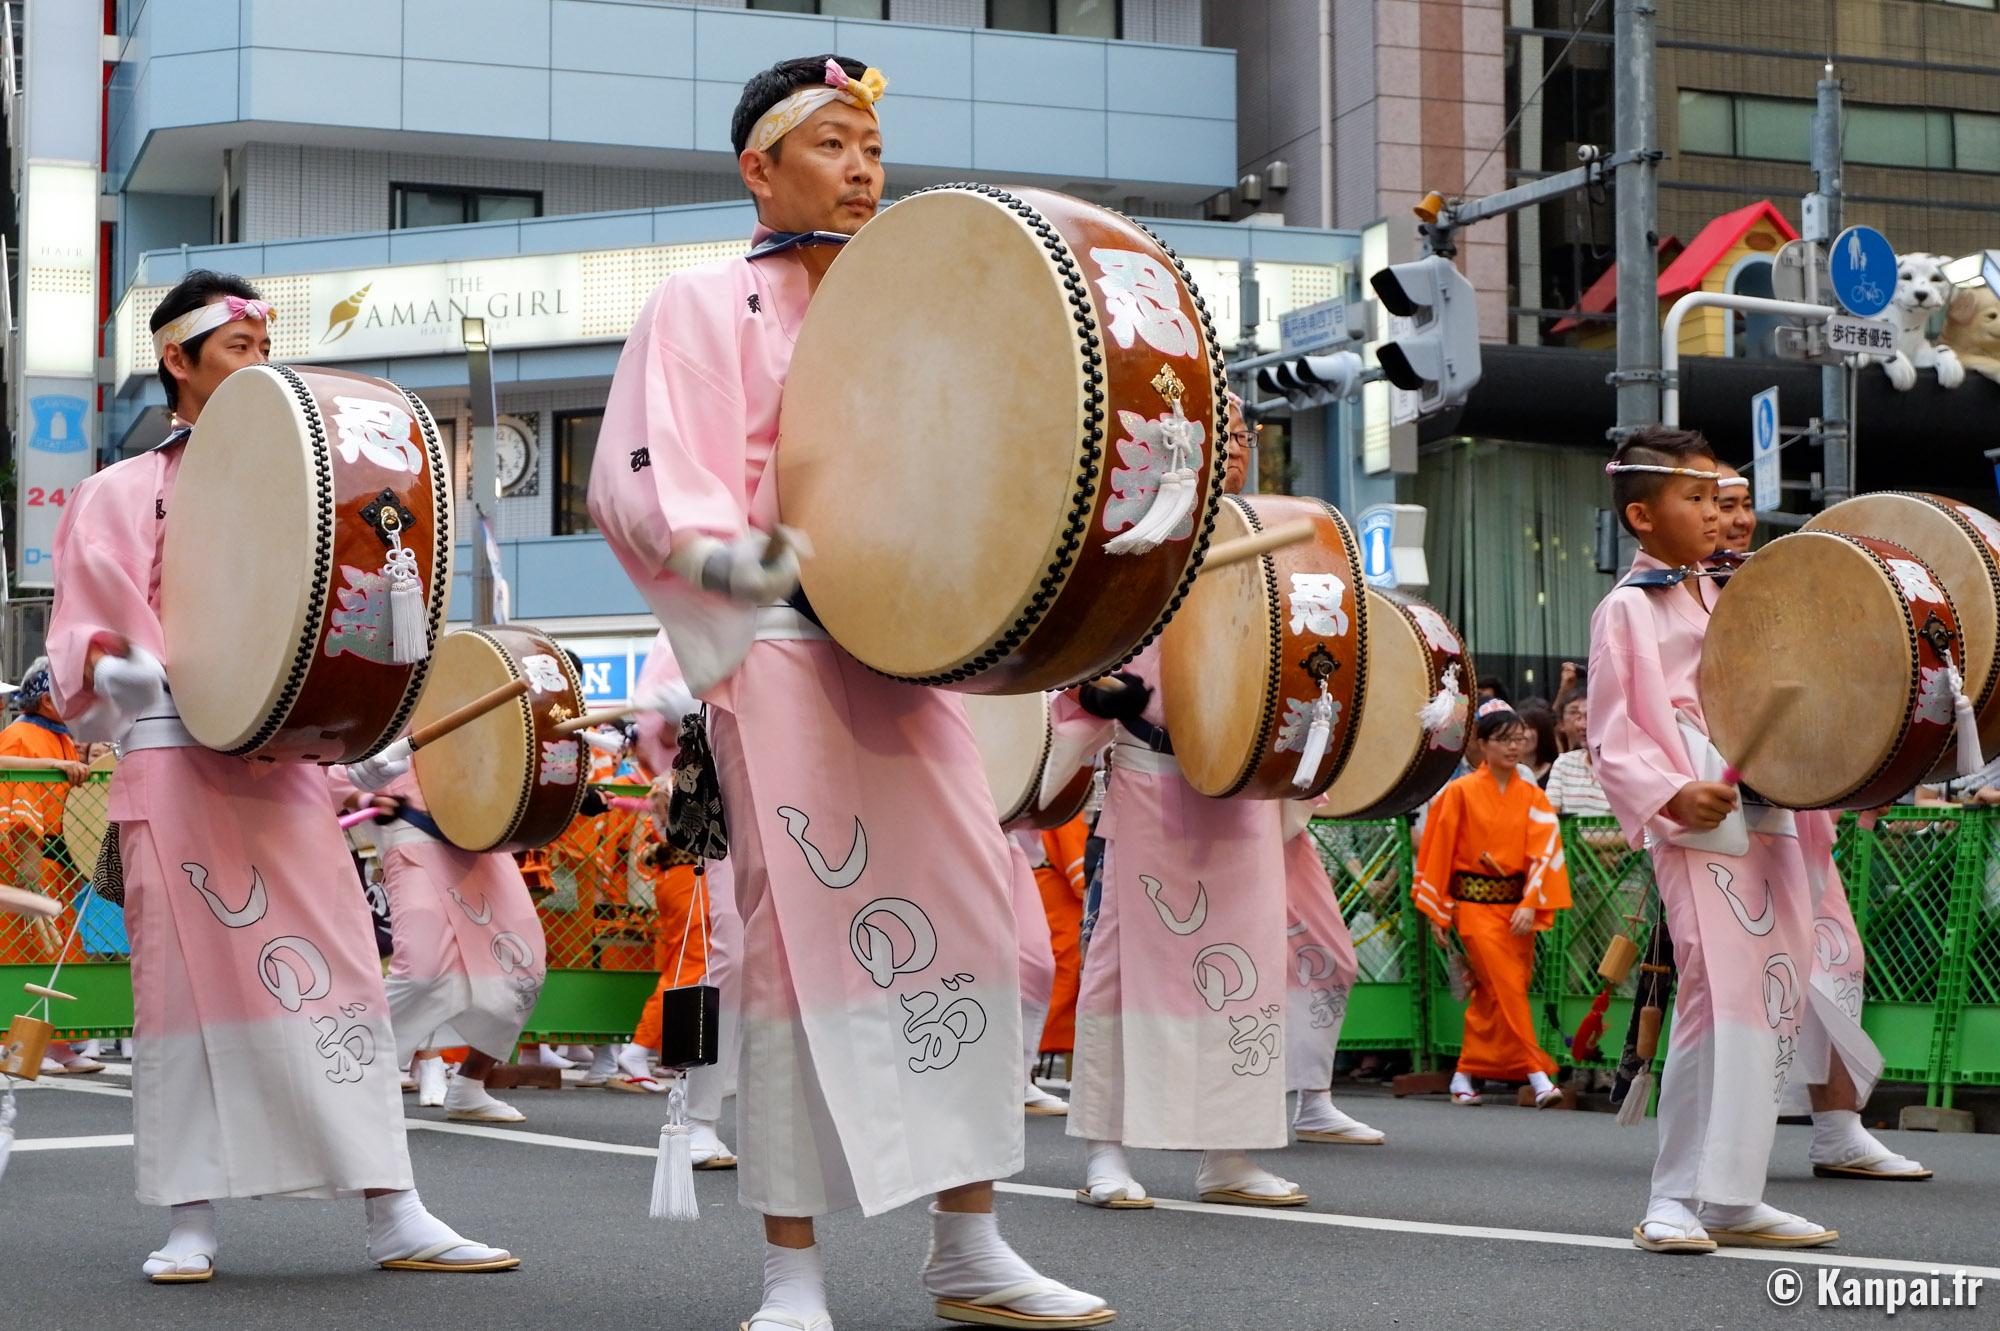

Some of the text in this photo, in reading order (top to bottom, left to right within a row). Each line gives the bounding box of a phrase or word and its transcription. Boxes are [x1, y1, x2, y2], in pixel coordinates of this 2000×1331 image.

[448, 275, 484, 294] THE
[364, 288, 569, 329] AMAN GIRL
[1832, 323, 1892, 349] 歩行者優先
